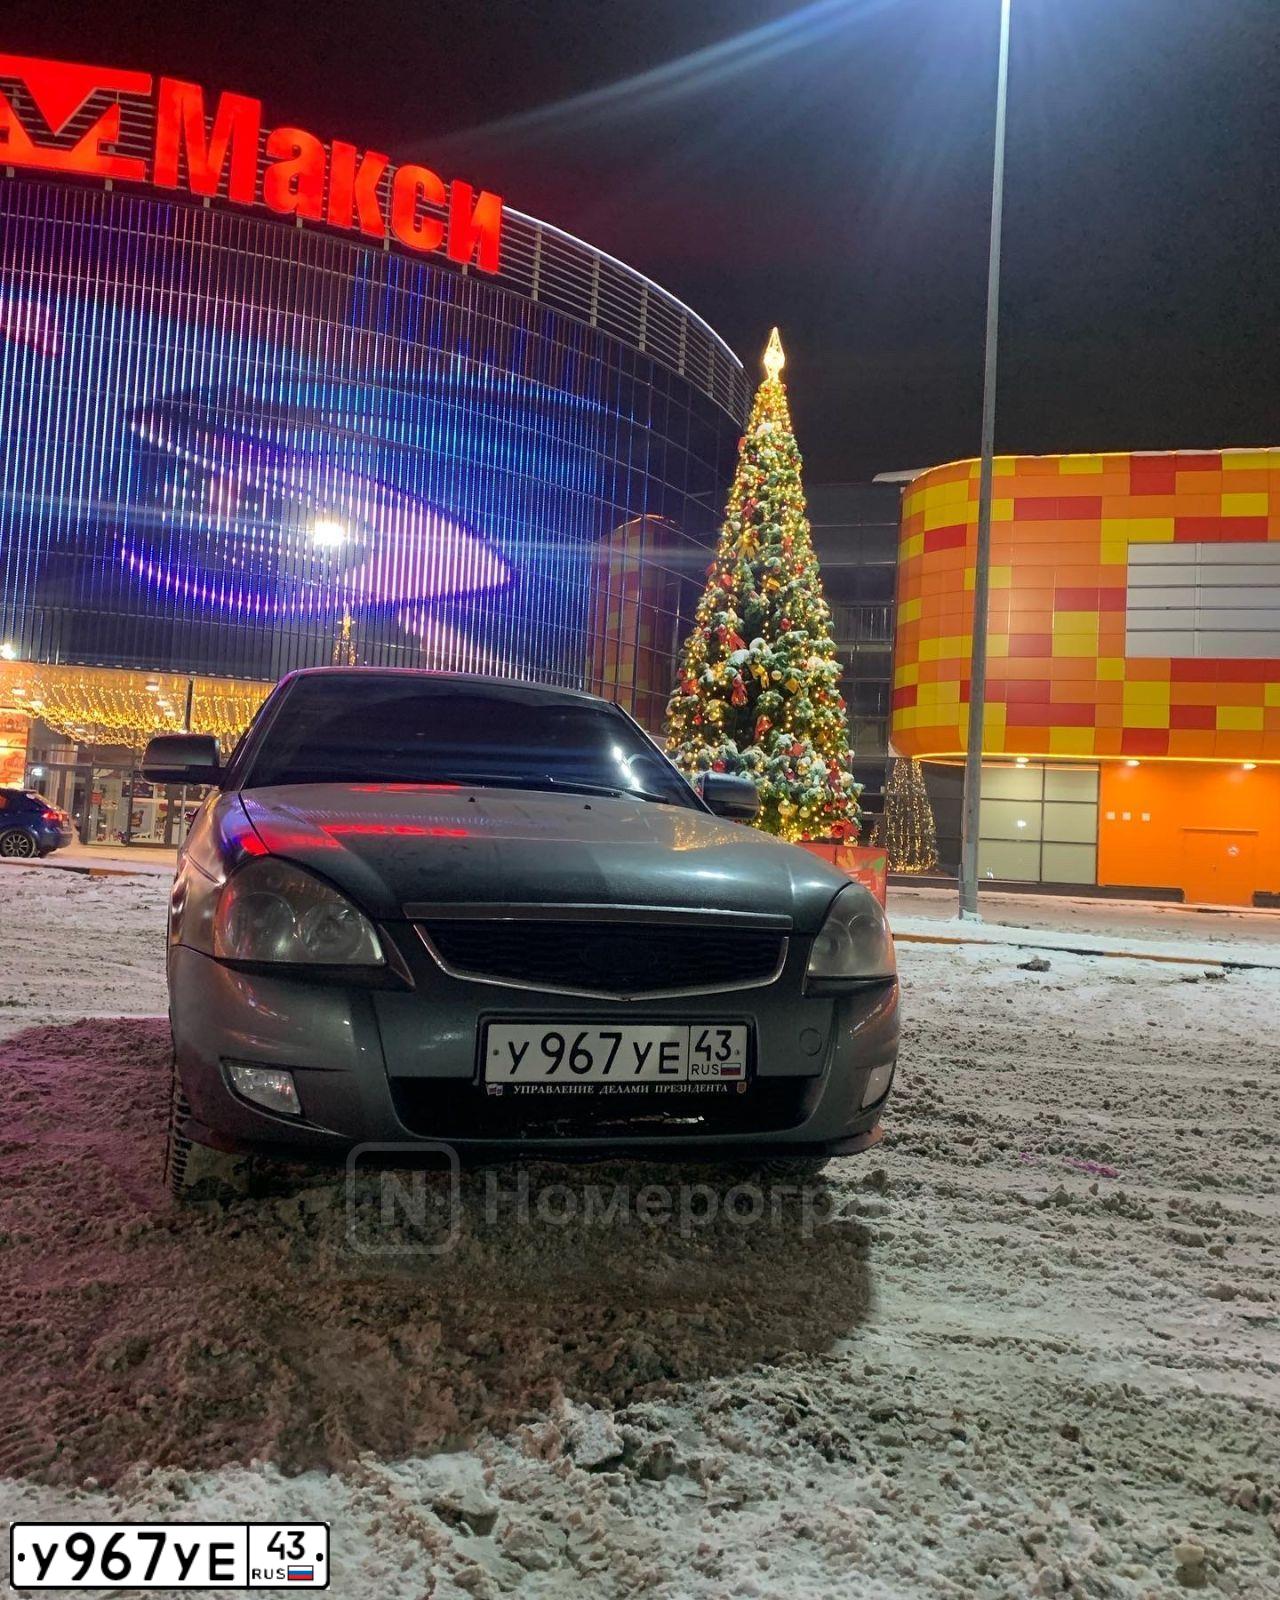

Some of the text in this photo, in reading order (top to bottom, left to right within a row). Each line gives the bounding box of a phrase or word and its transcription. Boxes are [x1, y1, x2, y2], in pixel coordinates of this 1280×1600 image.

[153, 76, 503, 275] Макси
[695, 1030, 732, 1061] 43
[691, 1064, 719, 1076] RUS
[513, 1083, 728, 1095] УПРАВЛЕНИЕ ДЕЛАМИ ПРЕЗИДЕНТА
